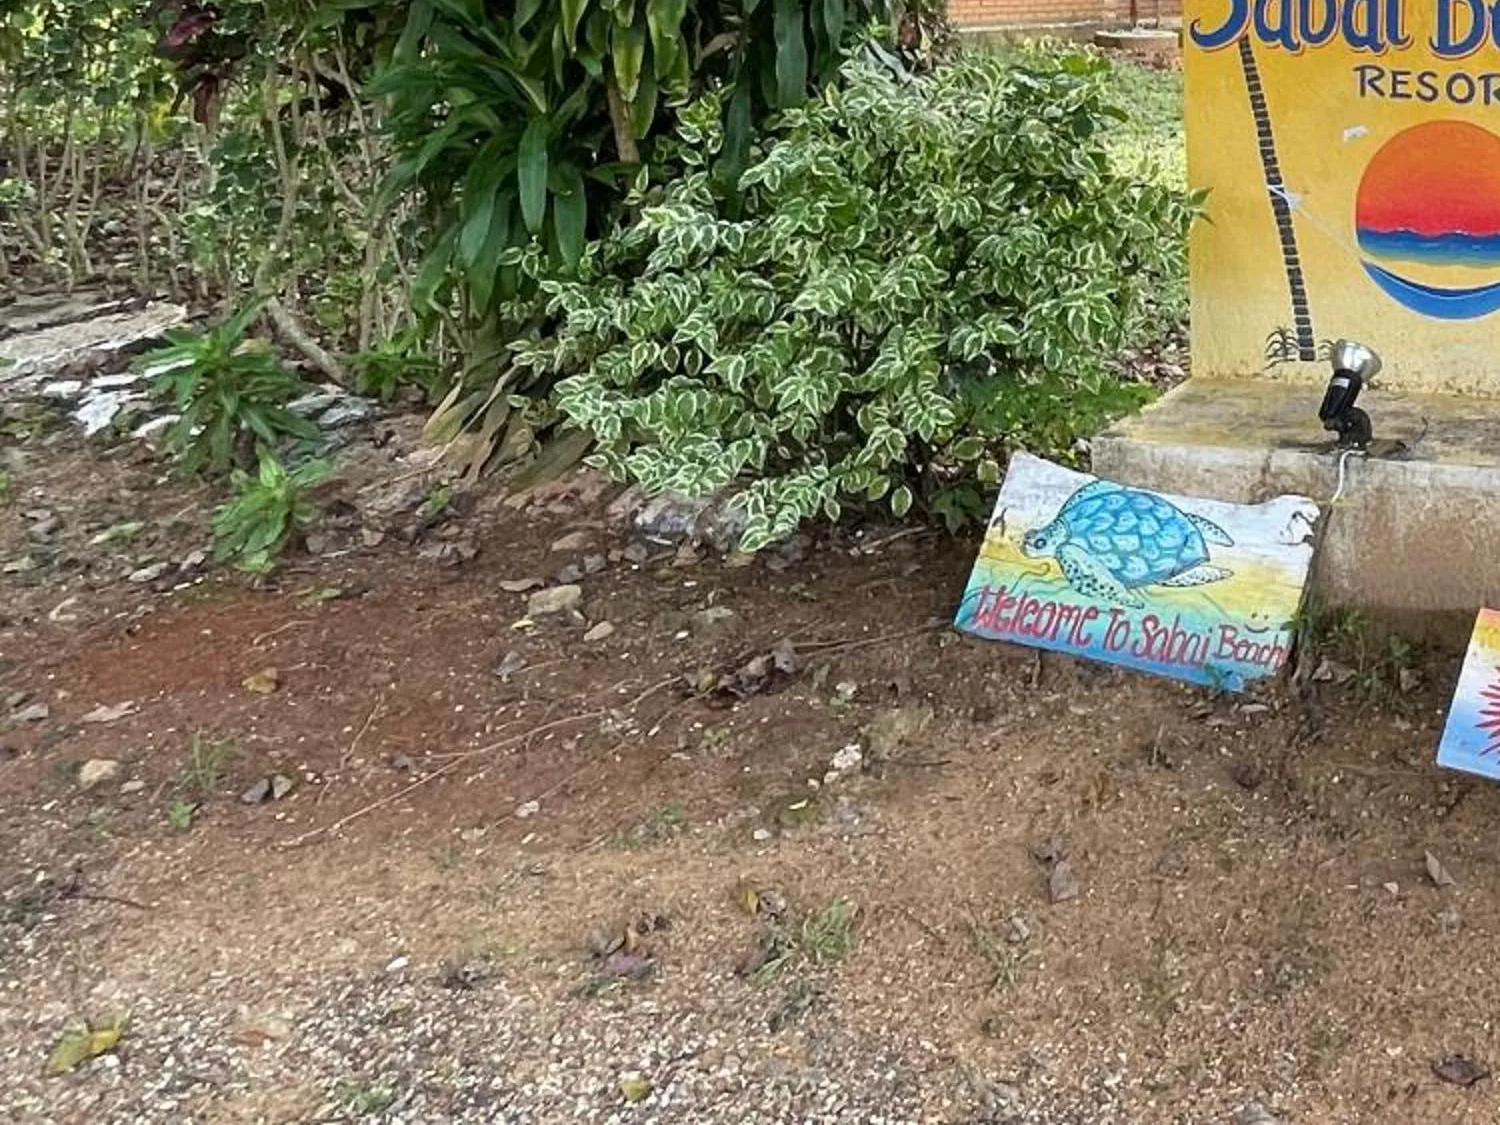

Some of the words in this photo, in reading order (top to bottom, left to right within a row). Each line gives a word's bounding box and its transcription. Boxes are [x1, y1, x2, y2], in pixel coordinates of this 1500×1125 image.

[972, 584, 1099, 647] Welcome
[1101, 608, 1131, 653] To
[1131, 613, 1213, 667] Sabai
